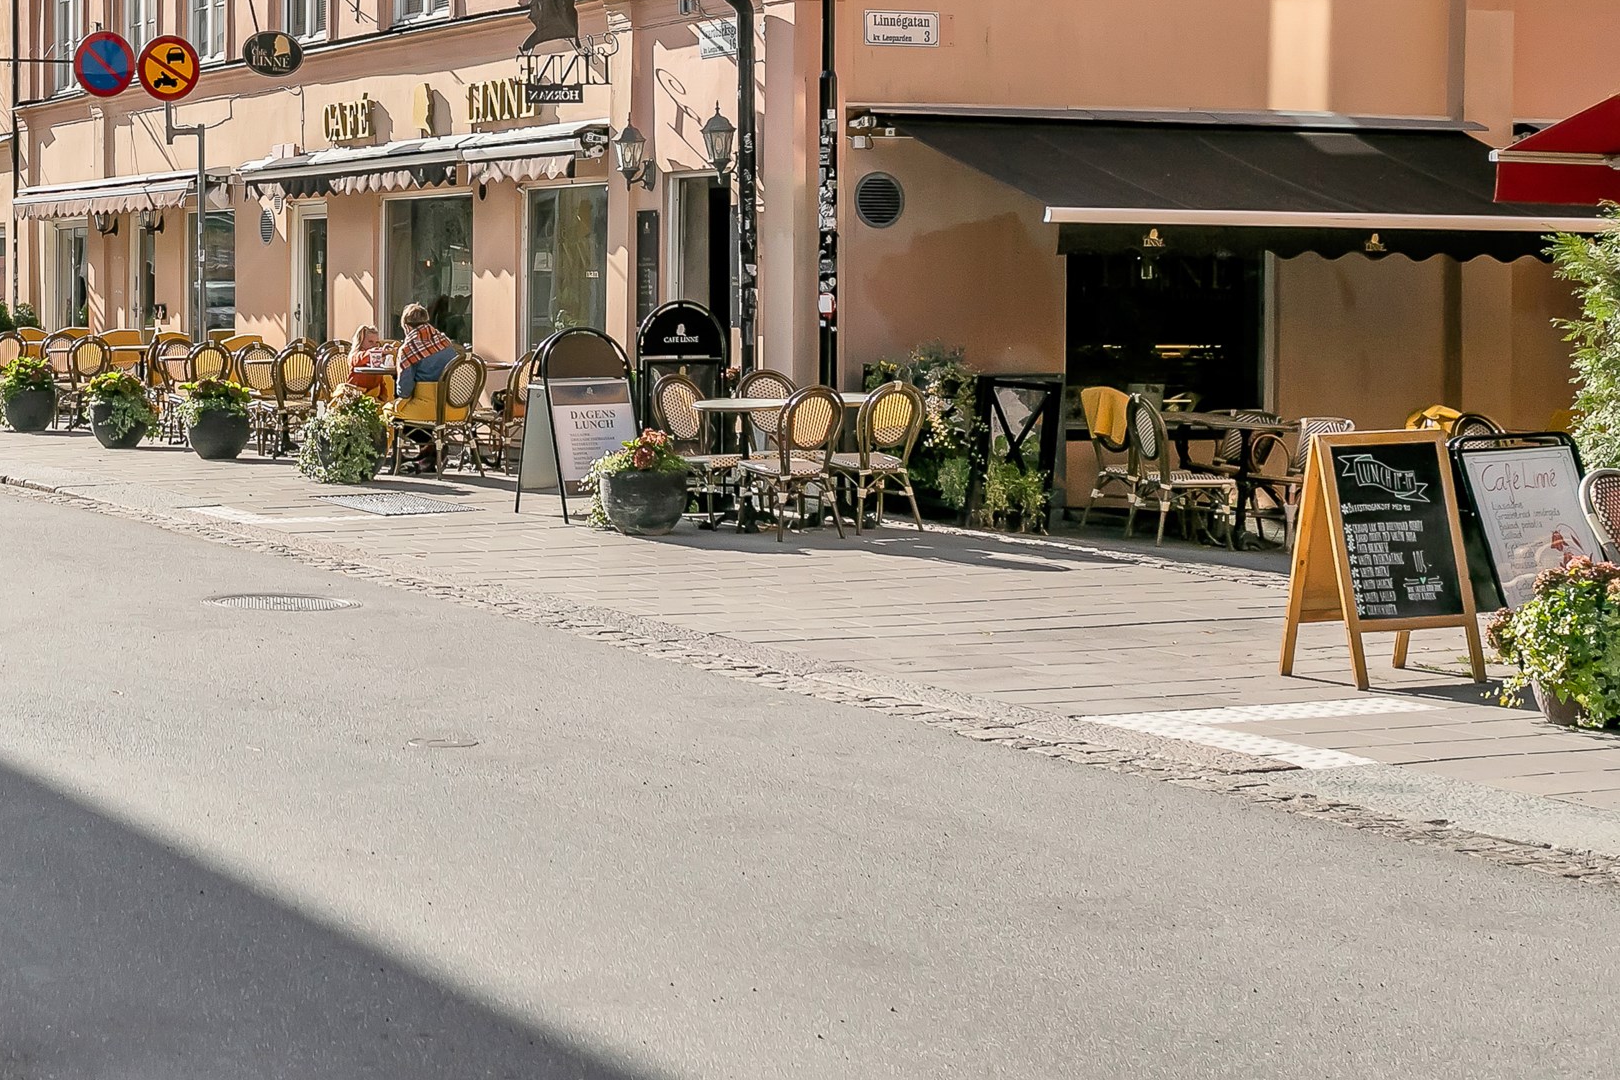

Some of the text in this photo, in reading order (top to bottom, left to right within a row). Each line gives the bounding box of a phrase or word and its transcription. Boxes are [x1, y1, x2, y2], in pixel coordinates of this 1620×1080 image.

[873, 14, 930, 30] Linnégatan
[924, 30, 930, 42] 3
[252, 54, 290, 69] LINNÉ
[323, 92, 375, 143] CAFÉ
[570, 409, 616, 420] DAGENS
[575, 420, 614, 430] LUNCH
[1357, 463, 1393, 489] LUNCH
[1481, 461, 1558, 504] Café Linné
